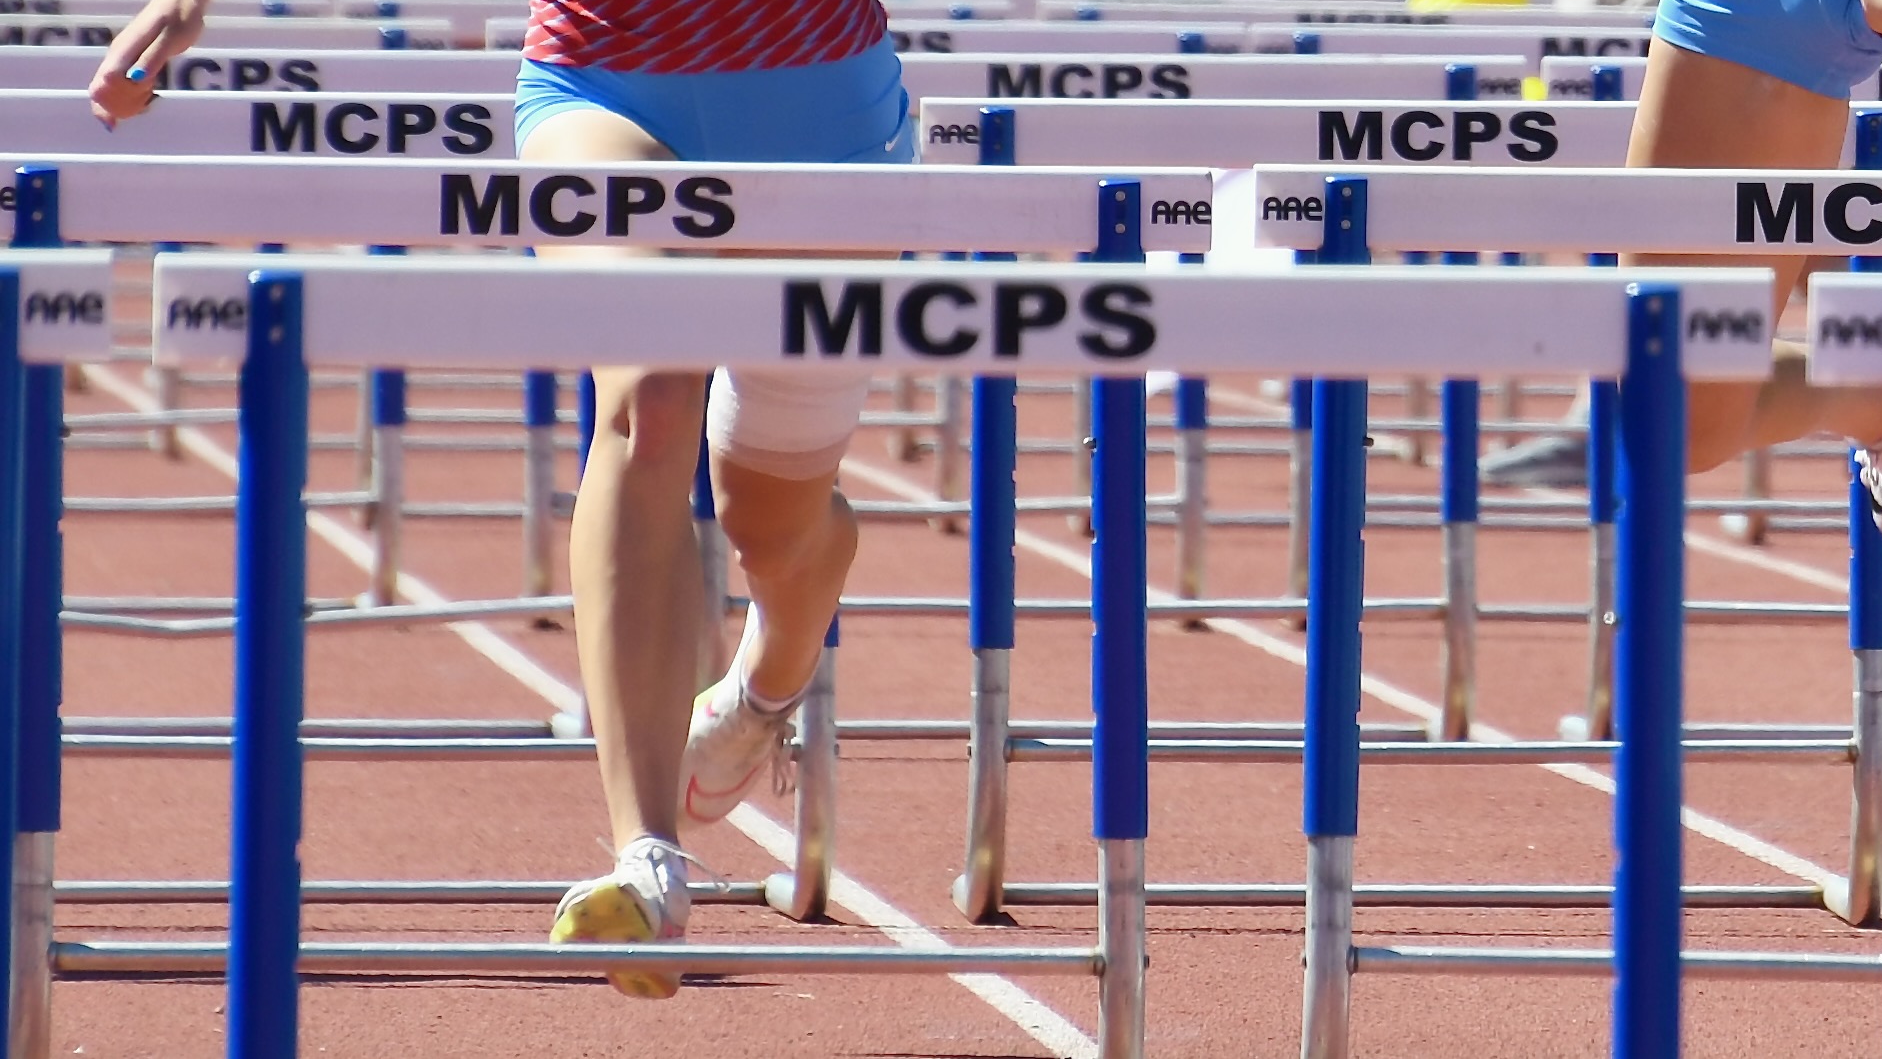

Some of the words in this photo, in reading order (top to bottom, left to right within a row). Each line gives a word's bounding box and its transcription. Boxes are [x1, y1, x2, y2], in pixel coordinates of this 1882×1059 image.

[987, 63, 1191, 98] MCPS
[251, 102, 494, 155] MCPS
[1318, 110, 1559, 162] MCPS
[440, 173, 736, 238] MCPS
[781, 281, 1157, 360] MCPS
